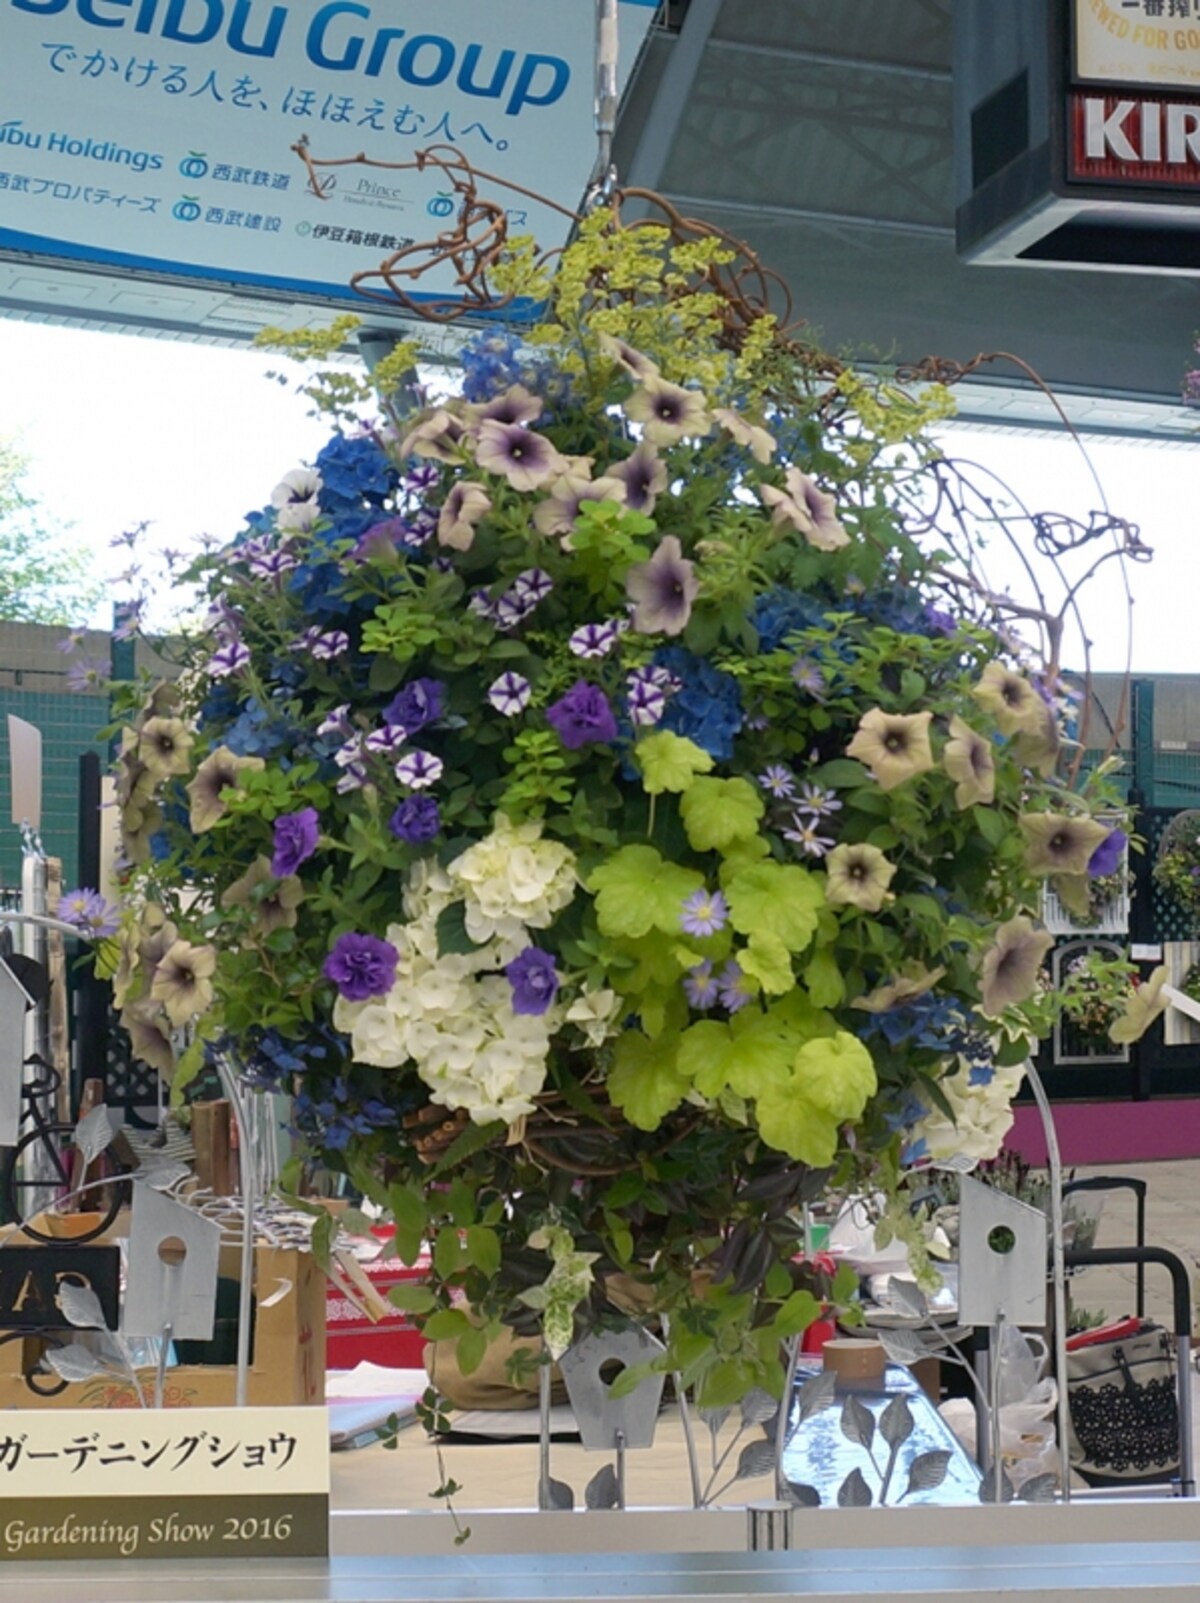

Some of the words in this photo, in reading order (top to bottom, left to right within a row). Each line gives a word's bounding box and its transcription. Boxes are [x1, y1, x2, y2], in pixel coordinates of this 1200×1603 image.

[1131, 23, 1168, 49] FOR
[305, 0, 571, 116] Group
[41, 42, 509, 151] でかける人を、ほほえむ人へ。
[1085, 98, 1200, 163] KIR
[47, 132, 164, 172] Holdings
[211, 163, 291, 191] 西武鉄道
[357, 178, 402, 198] Prince
[205, 206, 283, 233] 西武建設
[0, 1431, 297, 1474] ガーデニングショウ
[4, 1514, 139, 1555] Gardening
[147, 1513, 214, 1543] Show
[222, 1514, 293, 1540] 2016
